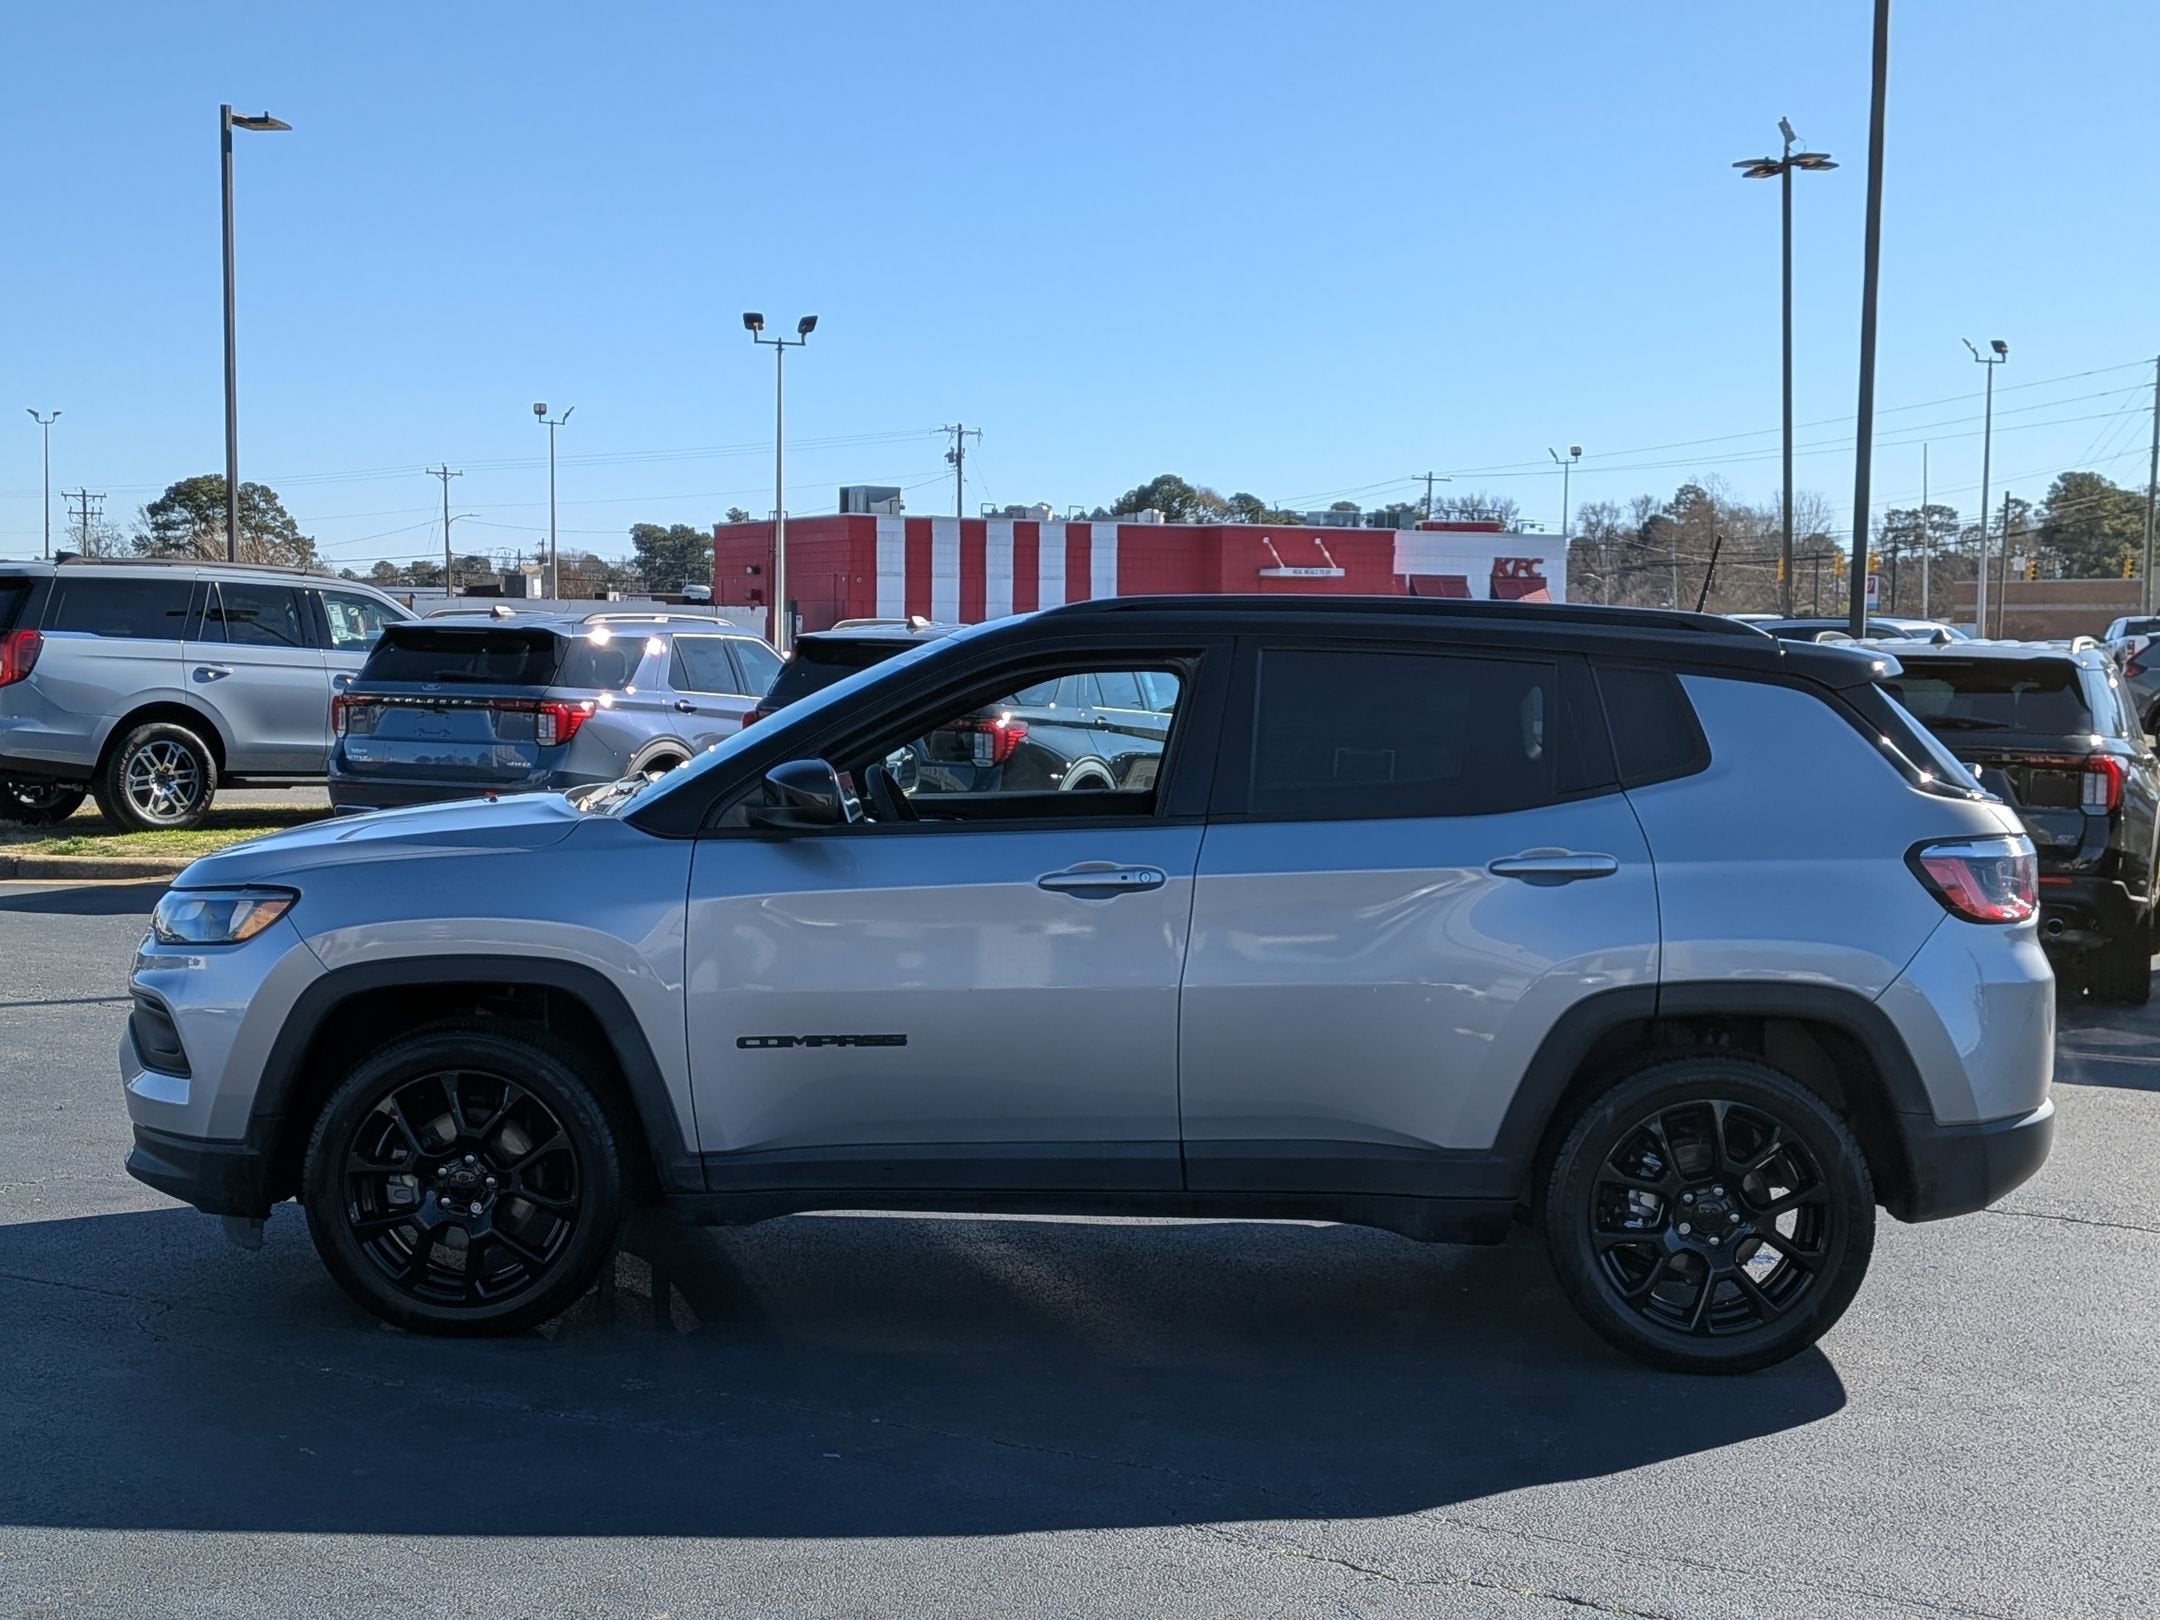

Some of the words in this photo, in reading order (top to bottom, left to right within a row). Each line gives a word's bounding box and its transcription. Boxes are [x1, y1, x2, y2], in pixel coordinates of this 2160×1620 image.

[1492, 557, 1544, 577] KFC
[382, 697, 472, 705] EXPLORER
[736, 1034, 908, 1049] COMPASS
